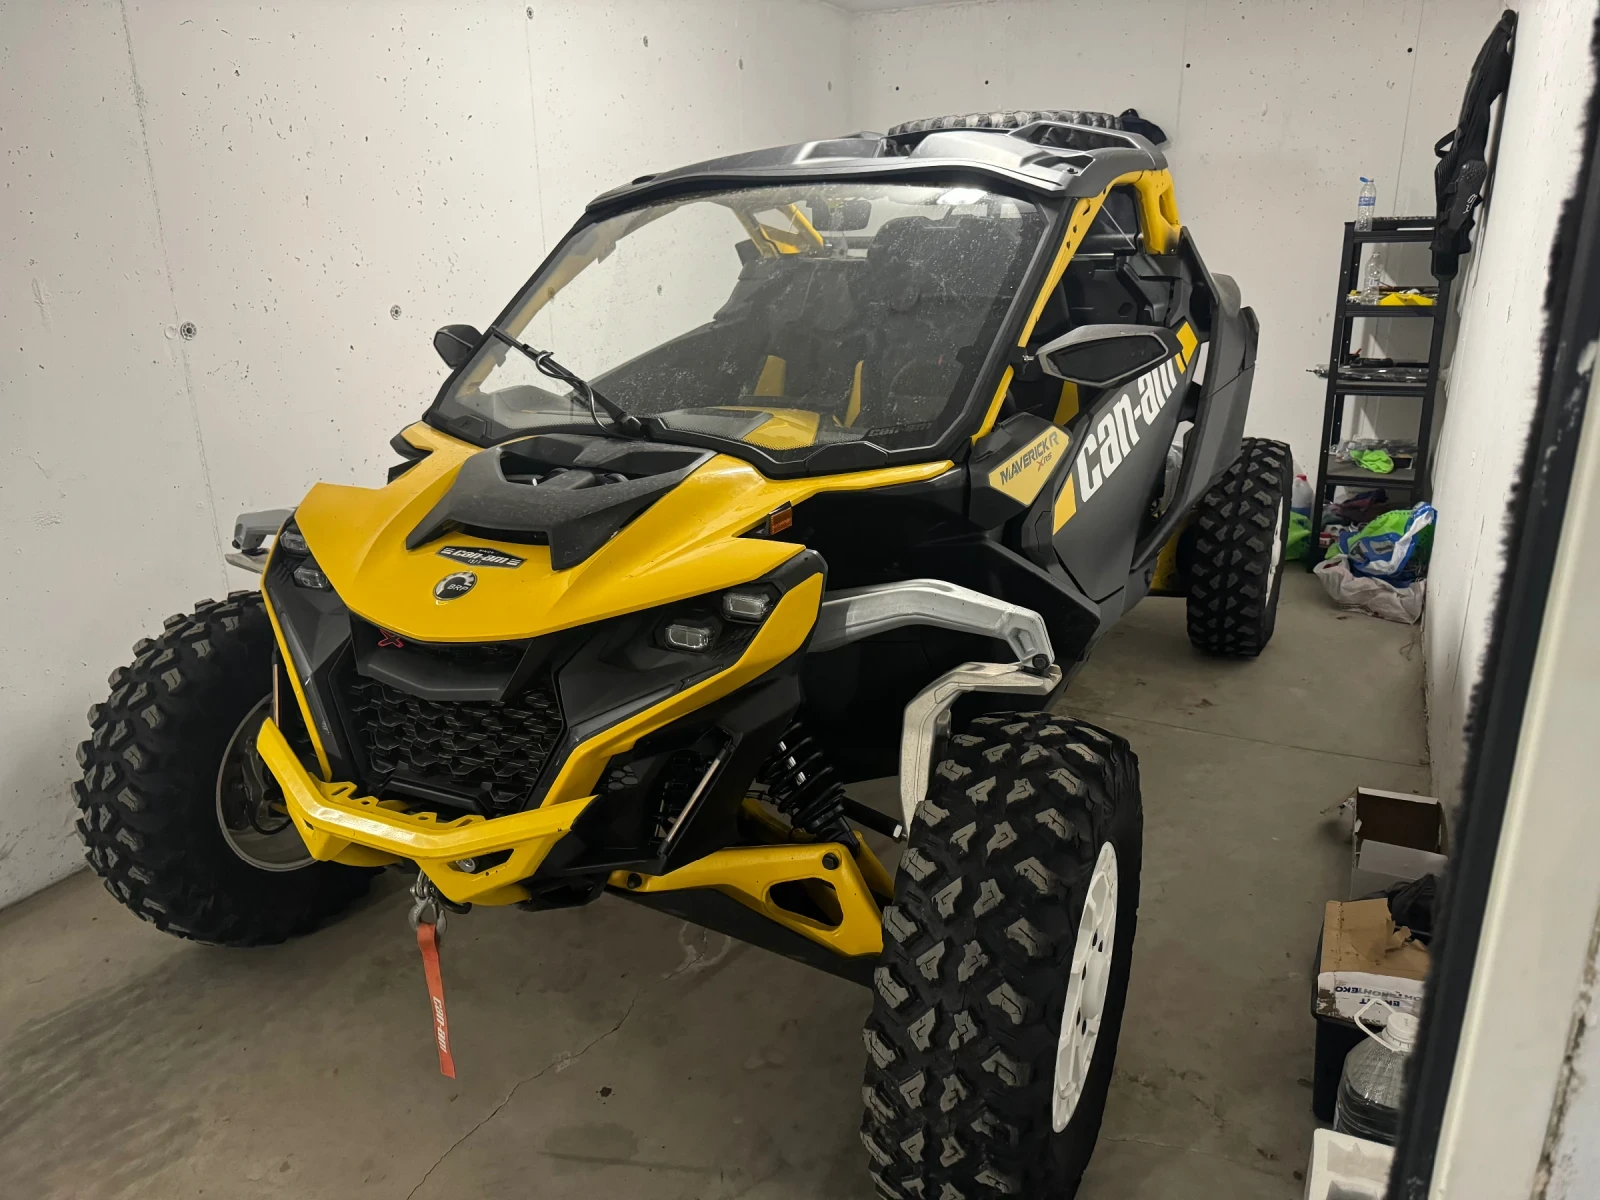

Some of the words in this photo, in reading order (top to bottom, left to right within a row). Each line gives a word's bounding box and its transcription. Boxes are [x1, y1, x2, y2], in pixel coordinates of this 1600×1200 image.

[1000, 437, 1050, 485] MAVERICK
[1049, 431, 1060, 447] R
[446, 583, 469, 592] BRP
